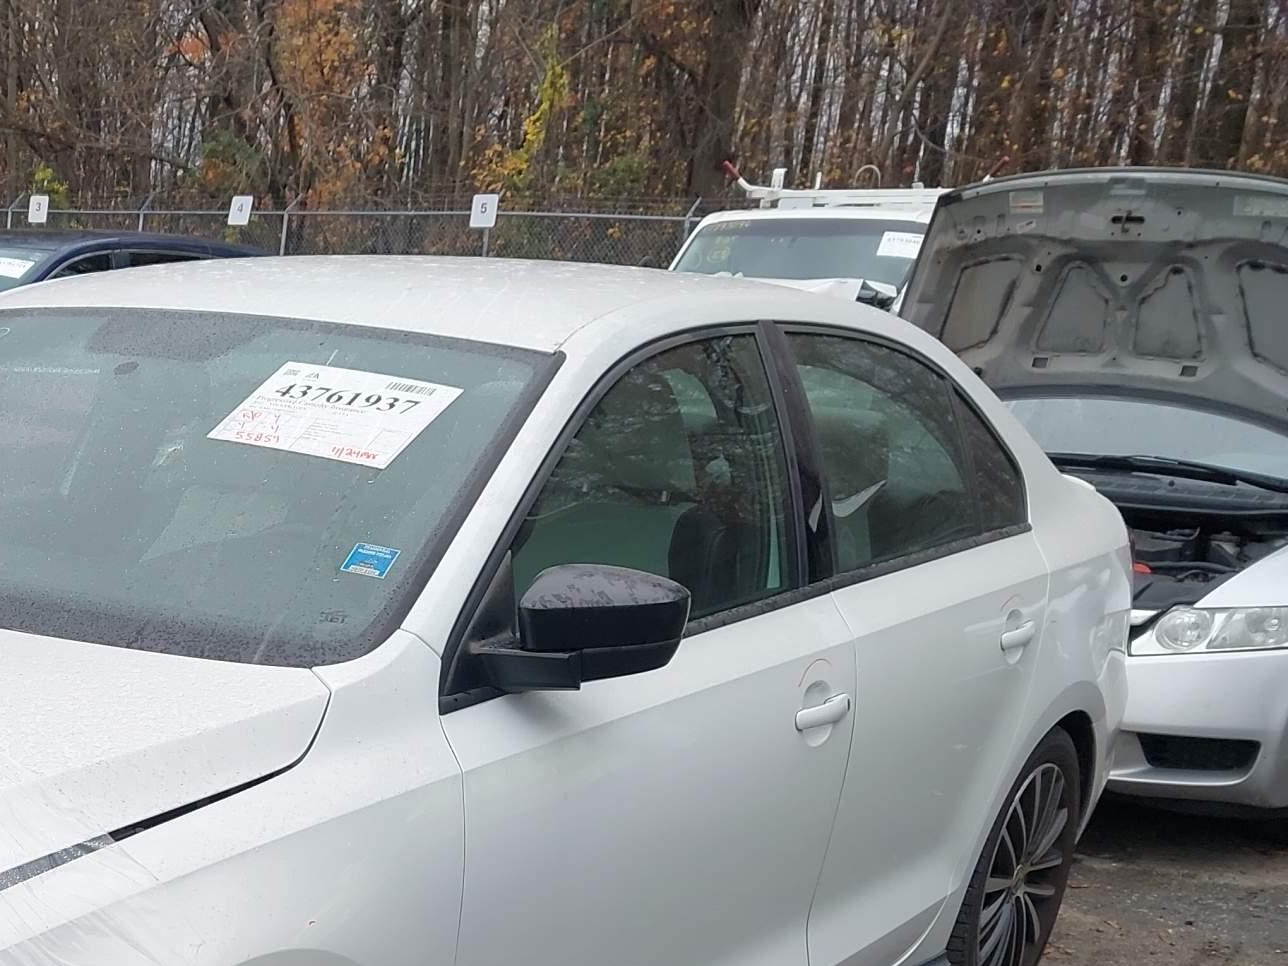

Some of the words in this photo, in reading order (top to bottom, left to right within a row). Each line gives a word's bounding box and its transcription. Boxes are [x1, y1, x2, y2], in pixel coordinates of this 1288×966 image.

[236, 203, 244, 214] 4
[480, 202, 488, 214] 5
[274, 382, 422, 415] 43761937
